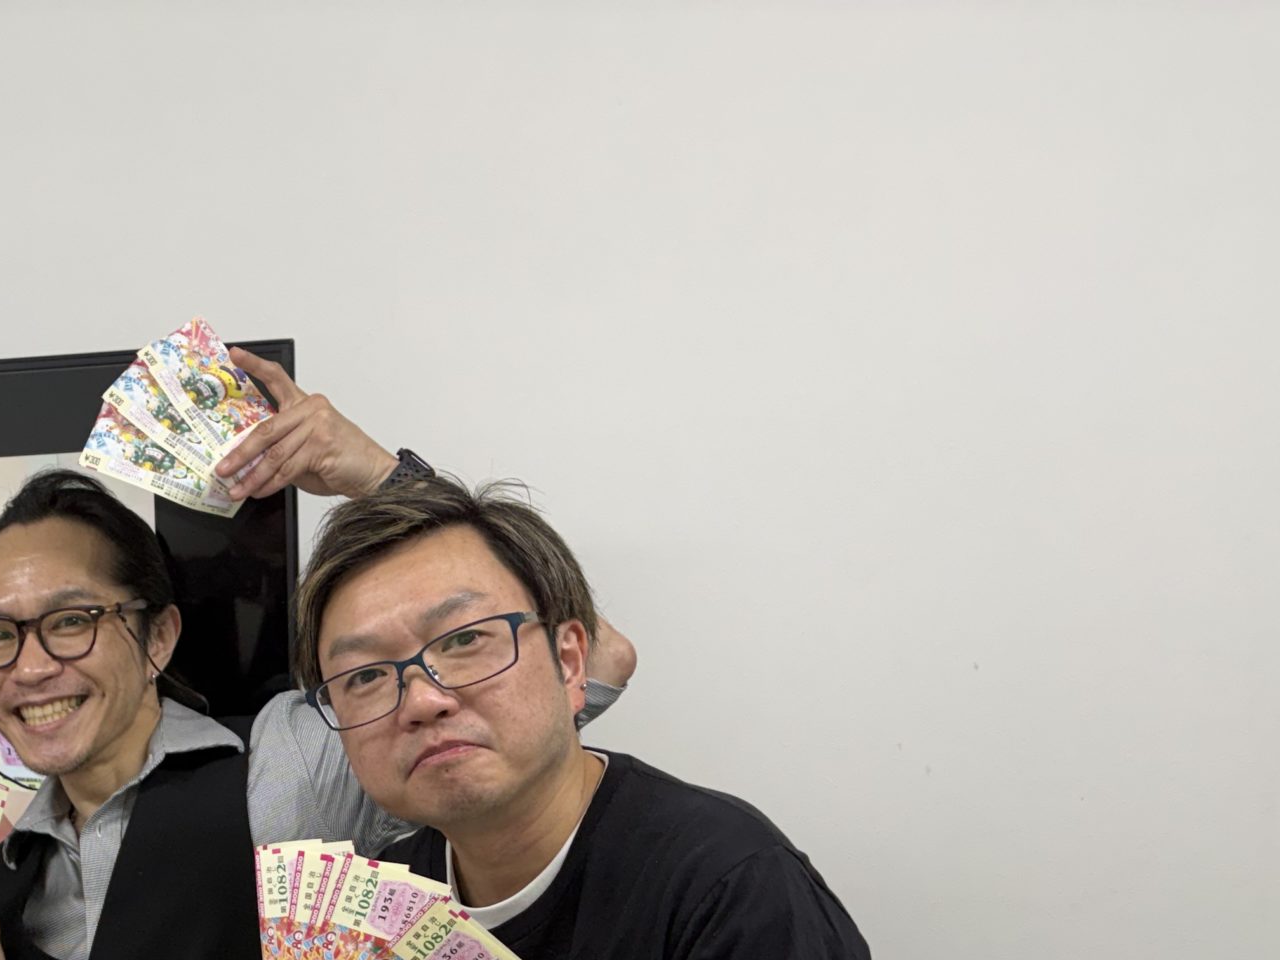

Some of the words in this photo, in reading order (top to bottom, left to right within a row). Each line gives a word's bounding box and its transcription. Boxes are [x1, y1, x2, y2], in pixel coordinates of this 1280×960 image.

[84, 453, 101, 466] ¥300
[276, 855, 288, 914] 第1082回
[325, 905, 334, 920] 300
[330, 889, 340, 905] 300
[336, 873, 346, 890] 300
[343, 857, 351, 873] 300
[341, 874, 361, 912] 全国自治
[353, 870, 380, 927] 第1082回
[377, 888, 397, 922] 193組
[387, 935, 400, 948] 300
[399, 923, 412, 936] 300
[412, 911, 424, 924] 300
[423, 899, 436, 912] 300
[405, 916, 439, 947] 全国自治
